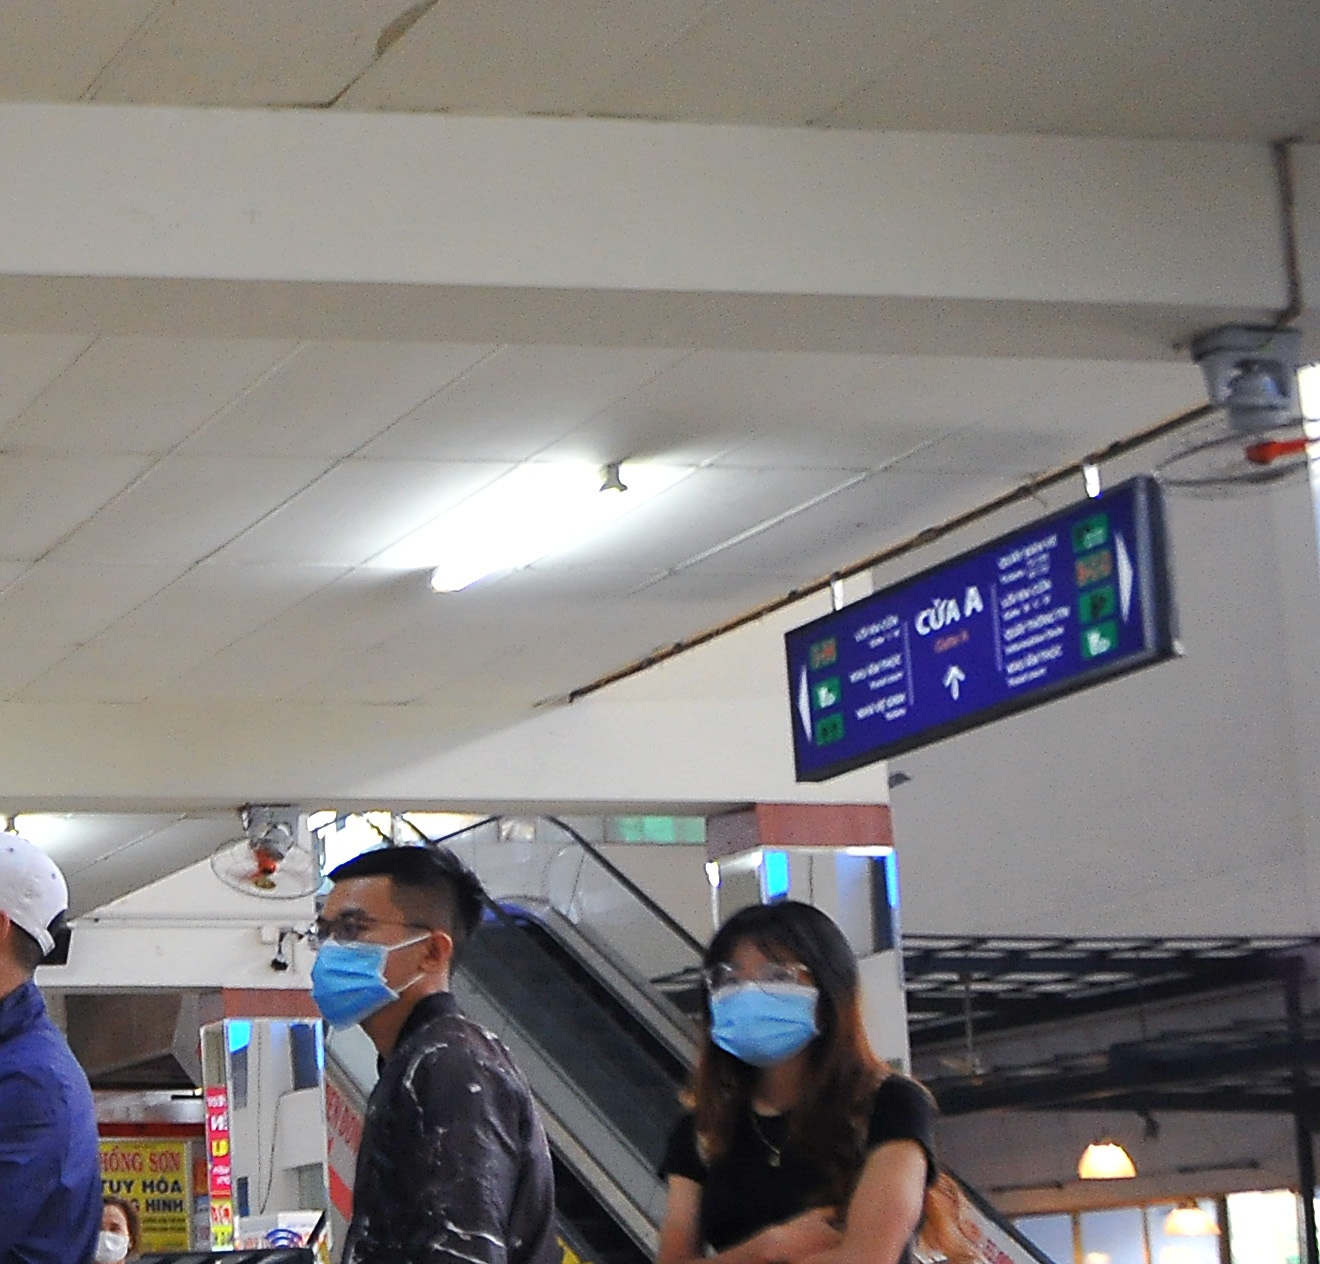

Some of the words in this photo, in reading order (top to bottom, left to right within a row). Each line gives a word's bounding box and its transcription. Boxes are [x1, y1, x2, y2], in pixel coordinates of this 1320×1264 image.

[915, 596, 962, 636] CỬA
[963, 585, 985, 618] A
[142, 1177, 182, 1194] HÒA
